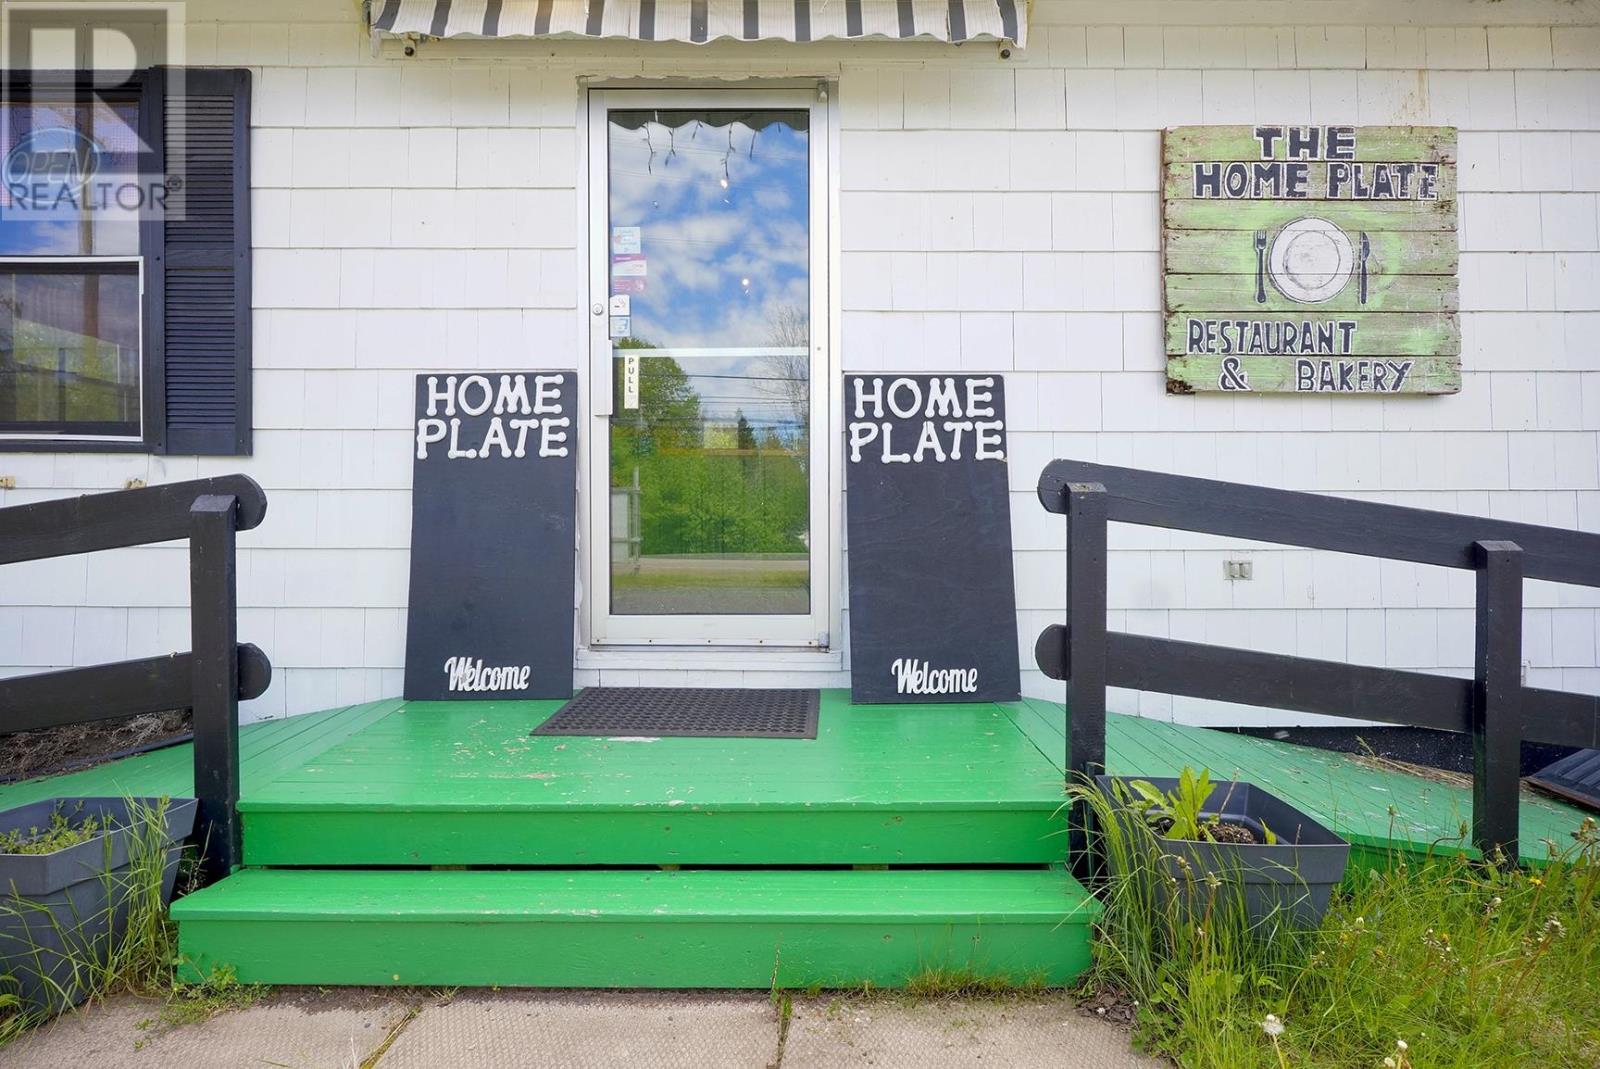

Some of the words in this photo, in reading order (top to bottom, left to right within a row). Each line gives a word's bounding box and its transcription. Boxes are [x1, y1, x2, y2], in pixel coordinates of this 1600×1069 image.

[1254, 126, 1356, 160] THE
[8, 149, 91, 184] OPEN
[1193, 162, 1308, 199] HOME
[1325, 162, 1439, 200] PLATE
[1187, 319, 1358, 355] RESTAURANT
[627, 356, 635, 394] PULL
[1219, 356, 1252, 392] &
[1295, 358, 1415, 392] BAKERY
[427, 374, 565, 416] HOME
[853, 377, 995, 419] HOME
[416, 416, 570, 459] PLATE
[849, 420, 1004, 463] PLATE
[444, 656, 531, 692] Welcome
[891, 658, 978, 694] Welcome
